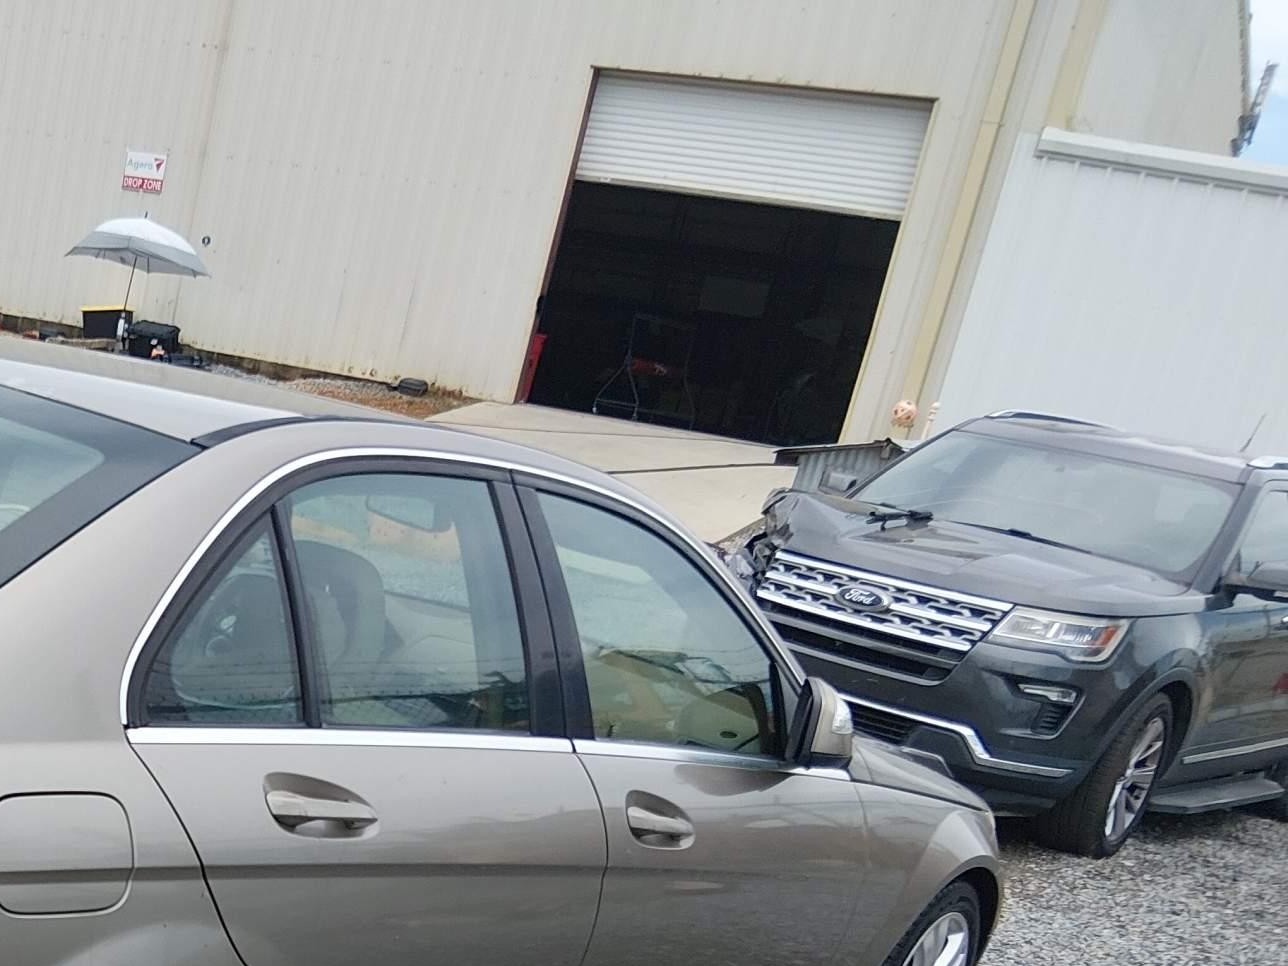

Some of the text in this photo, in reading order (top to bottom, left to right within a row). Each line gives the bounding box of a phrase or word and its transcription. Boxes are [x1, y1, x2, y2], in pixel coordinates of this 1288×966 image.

[127, 158, 153, 170] Agero
[124, 177, 162, 191] DROP ZONE
[844, 588, 876, 605] Ford
